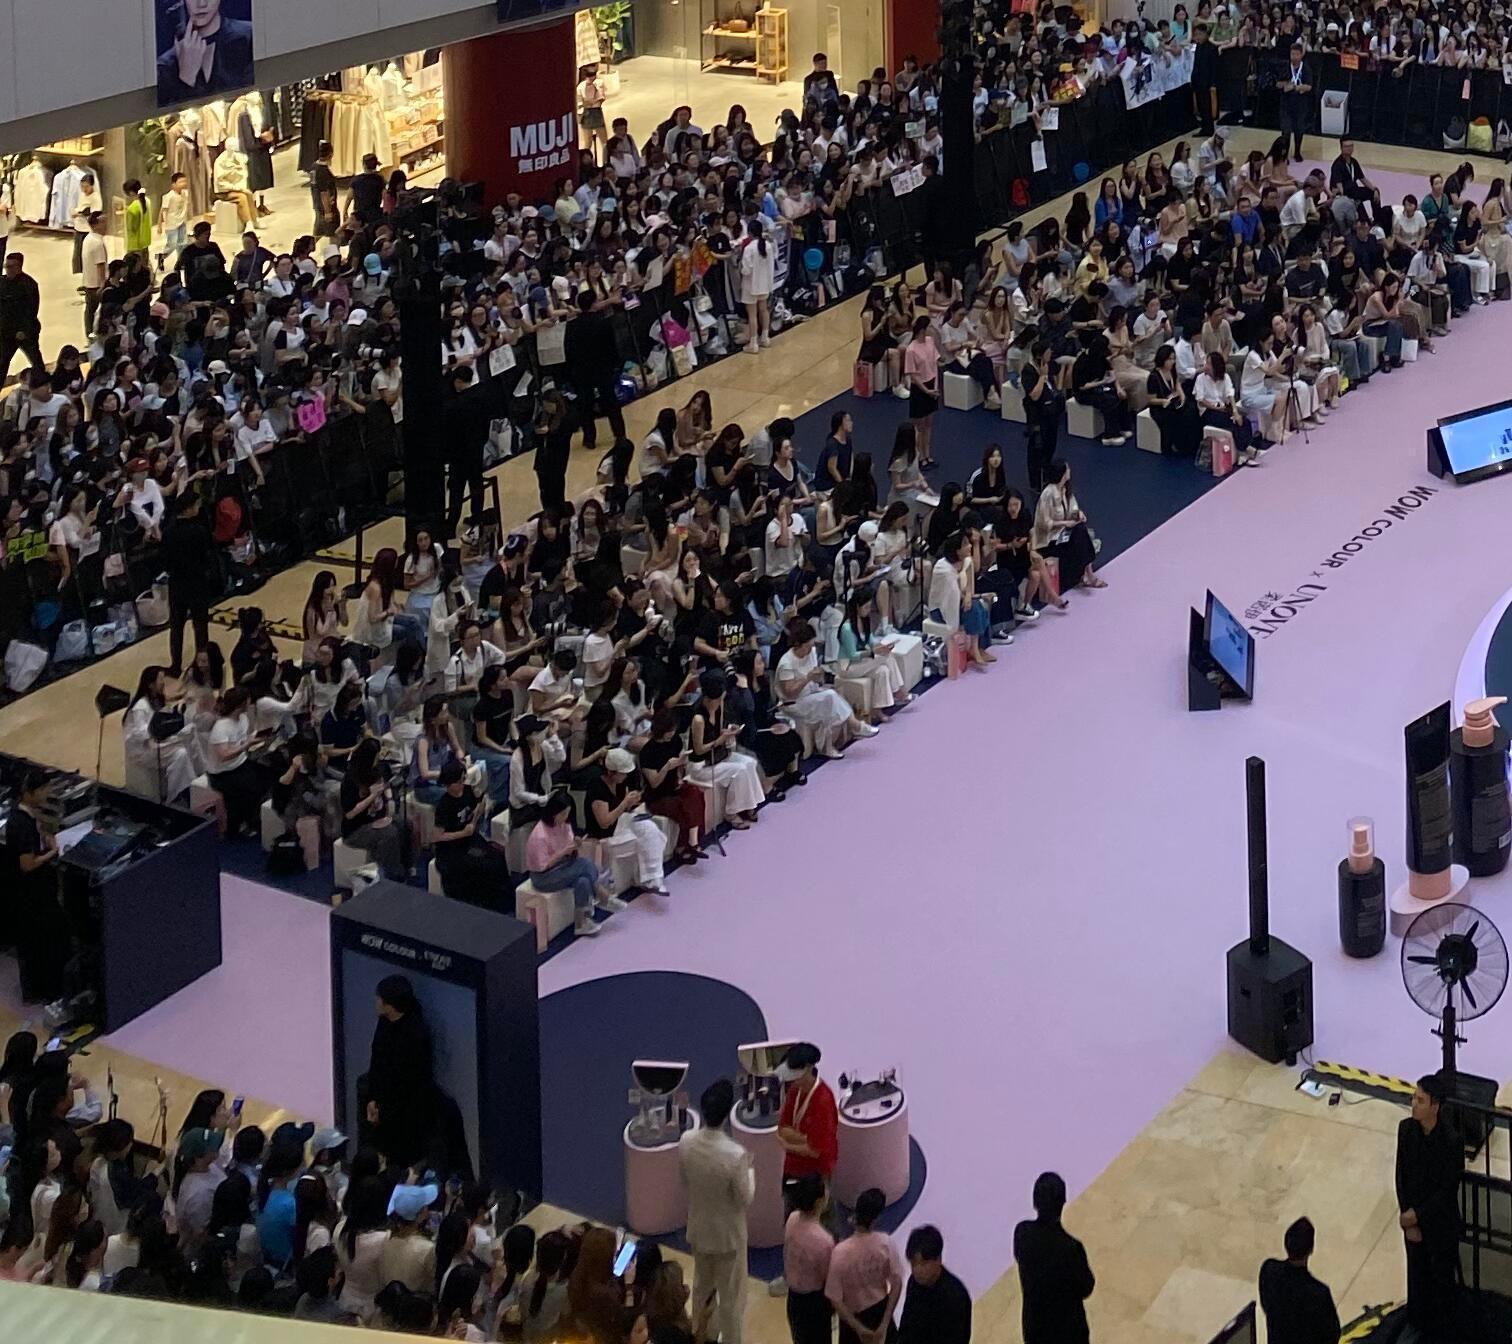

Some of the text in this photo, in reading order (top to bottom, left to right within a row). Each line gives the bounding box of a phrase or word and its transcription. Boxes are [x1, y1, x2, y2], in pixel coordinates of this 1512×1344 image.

[510, 112, 574, 158] MUJI
[1248, 485, 1439, 639] WOW COLOUR UNOVE
